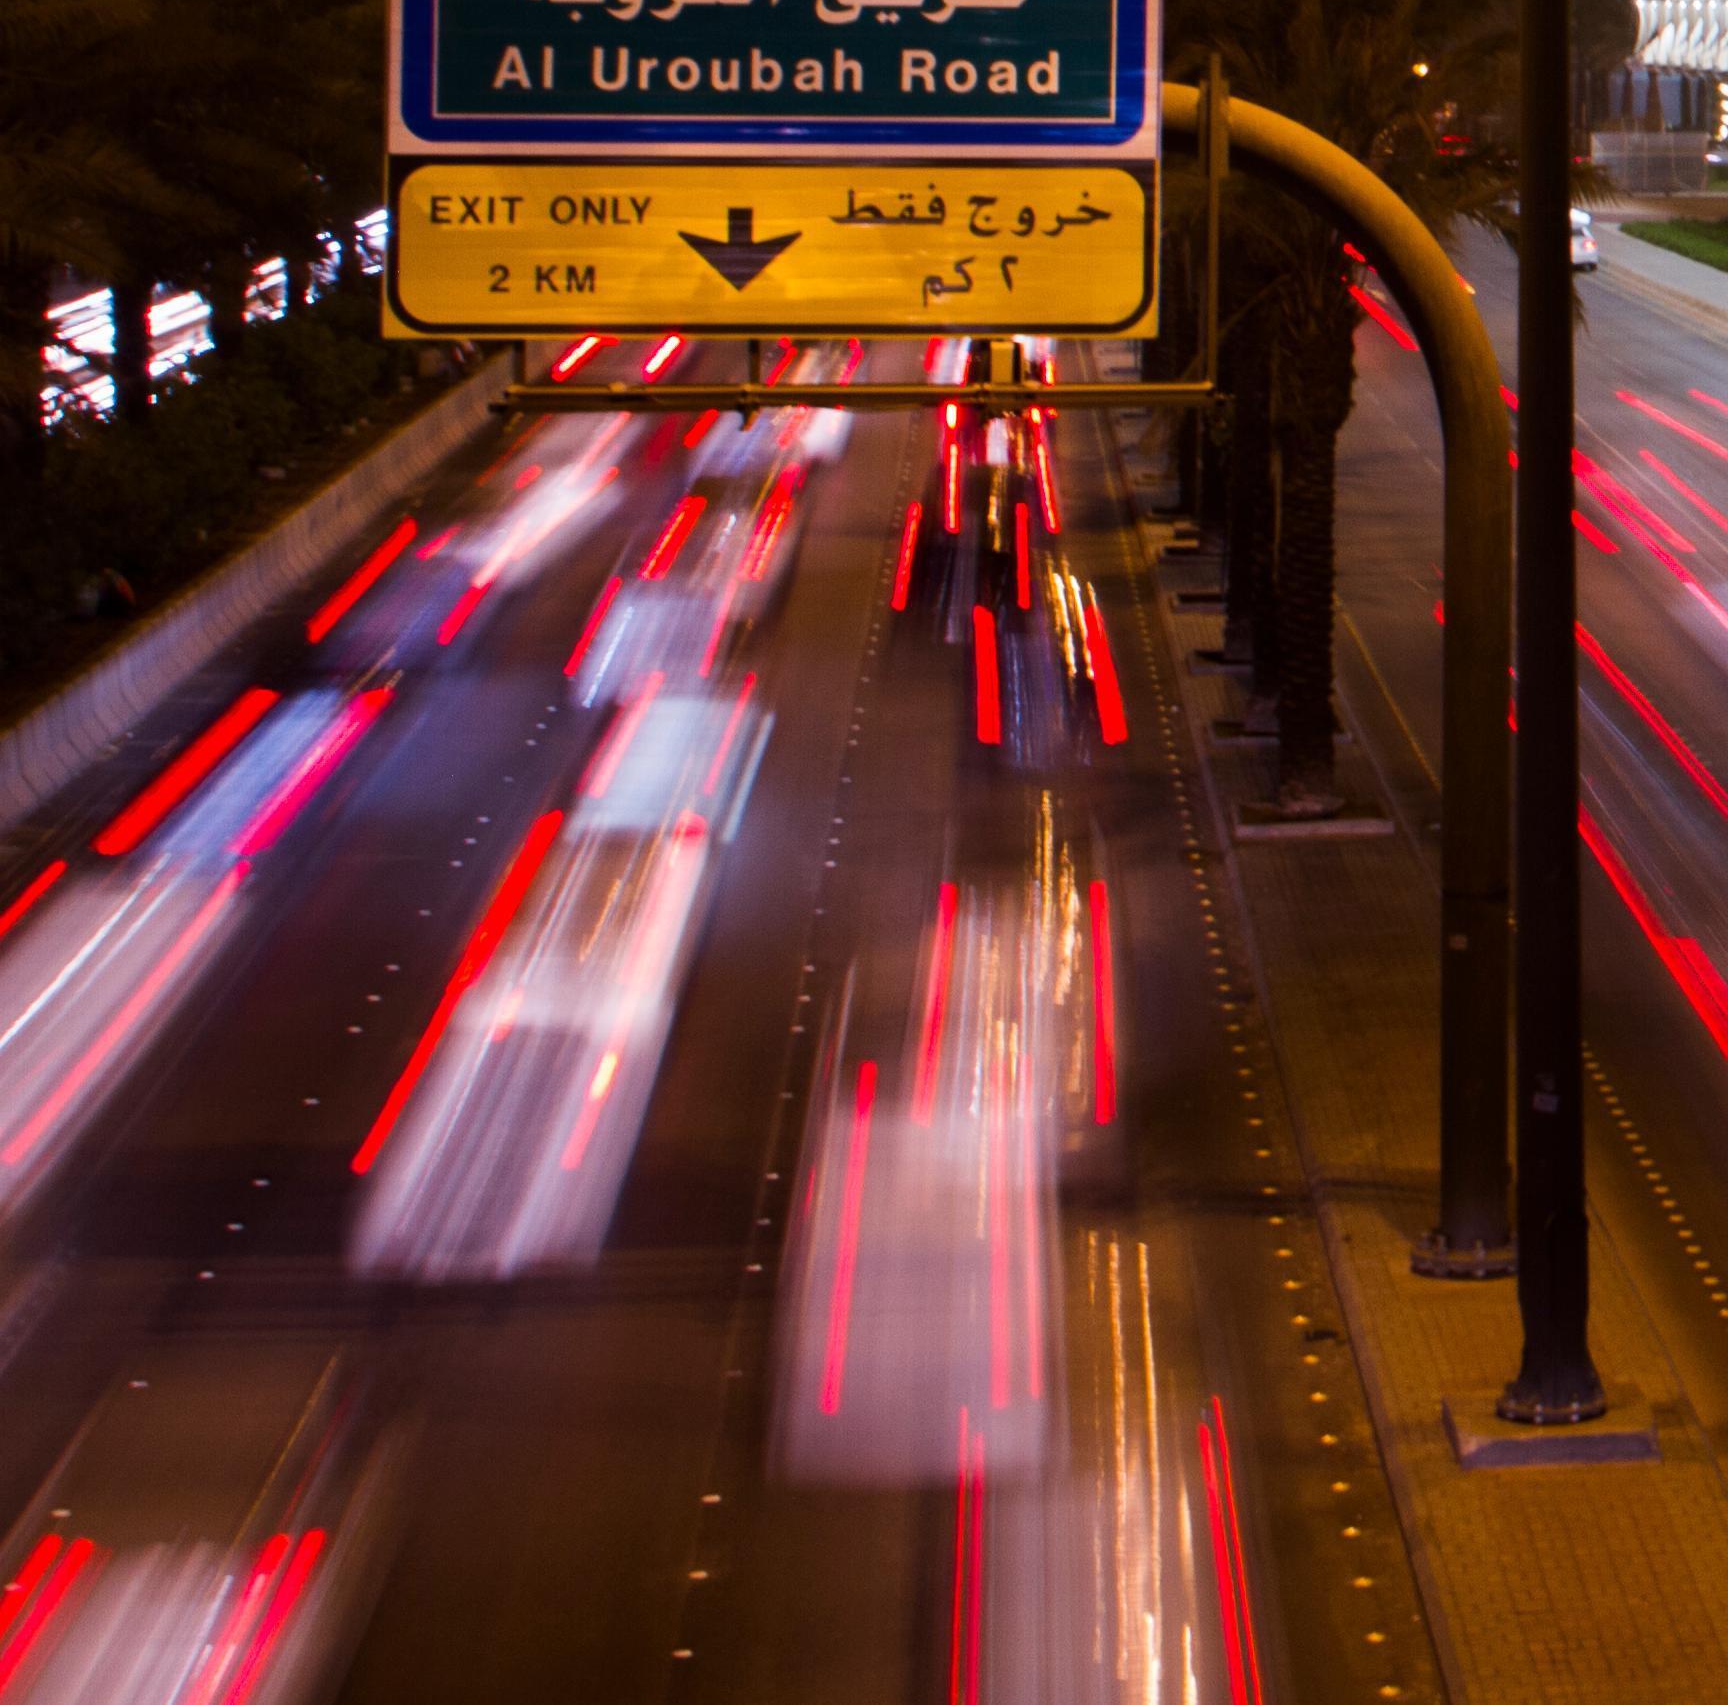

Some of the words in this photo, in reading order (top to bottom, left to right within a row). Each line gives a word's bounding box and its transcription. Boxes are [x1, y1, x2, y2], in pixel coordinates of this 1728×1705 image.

[493, 45, 554, 89] Al
[592, 46, 863, 92] Uroubah
[900, 49, 1060, 95] Road
[427, 195, 524, 226] EXIT
[548, 194, 651, 226] ONLY
[831, 182, 946, 226] فقط
[967, 192, 1112, 238] خروج
[487, 263, 510, 293] 2
[533, 264, 596, 293] KM
[921, 256, 975, 307] كم
[999, 255, 1019, 291] ٢
